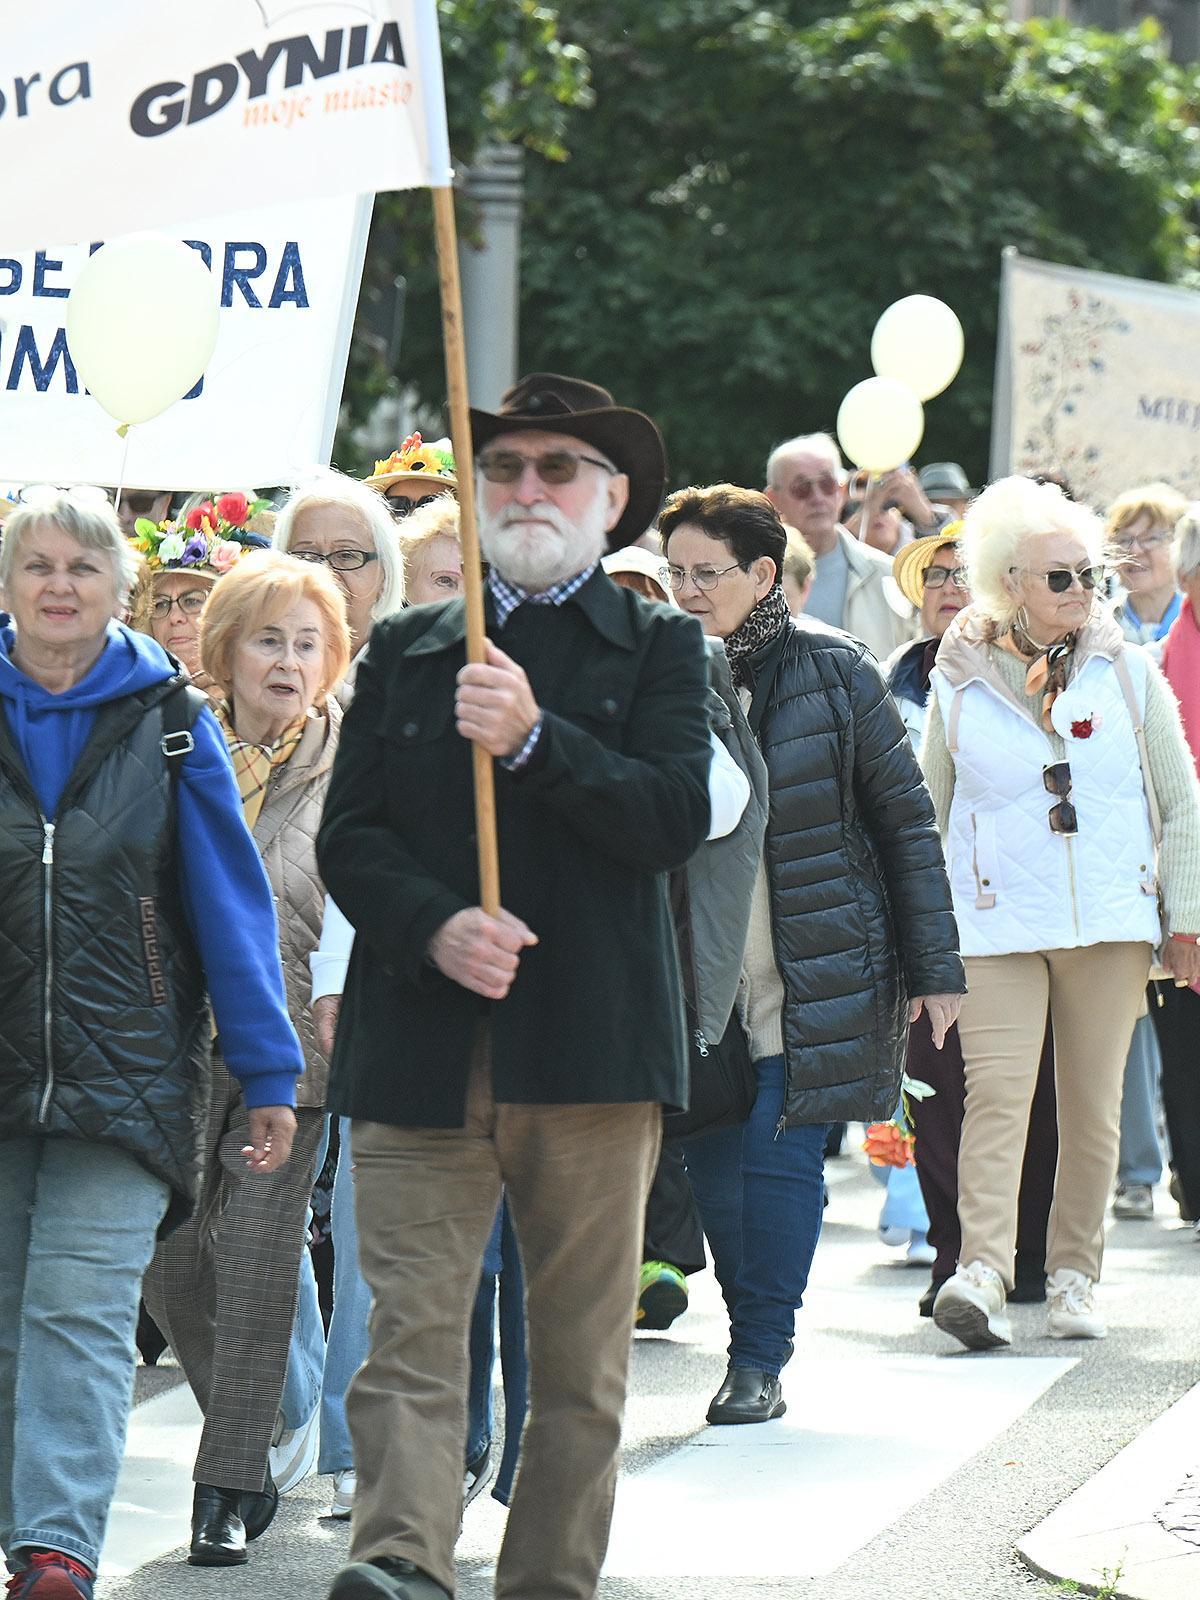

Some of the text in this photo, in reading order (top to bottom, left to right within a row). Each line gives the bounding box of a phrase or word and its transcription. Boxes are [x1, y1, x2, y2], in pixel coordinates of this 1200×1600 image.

[0, 61, 91, 121] ra
[129, 20, 407, 139] GDYNIA
[242, 80, 414, 129] moje miasto
